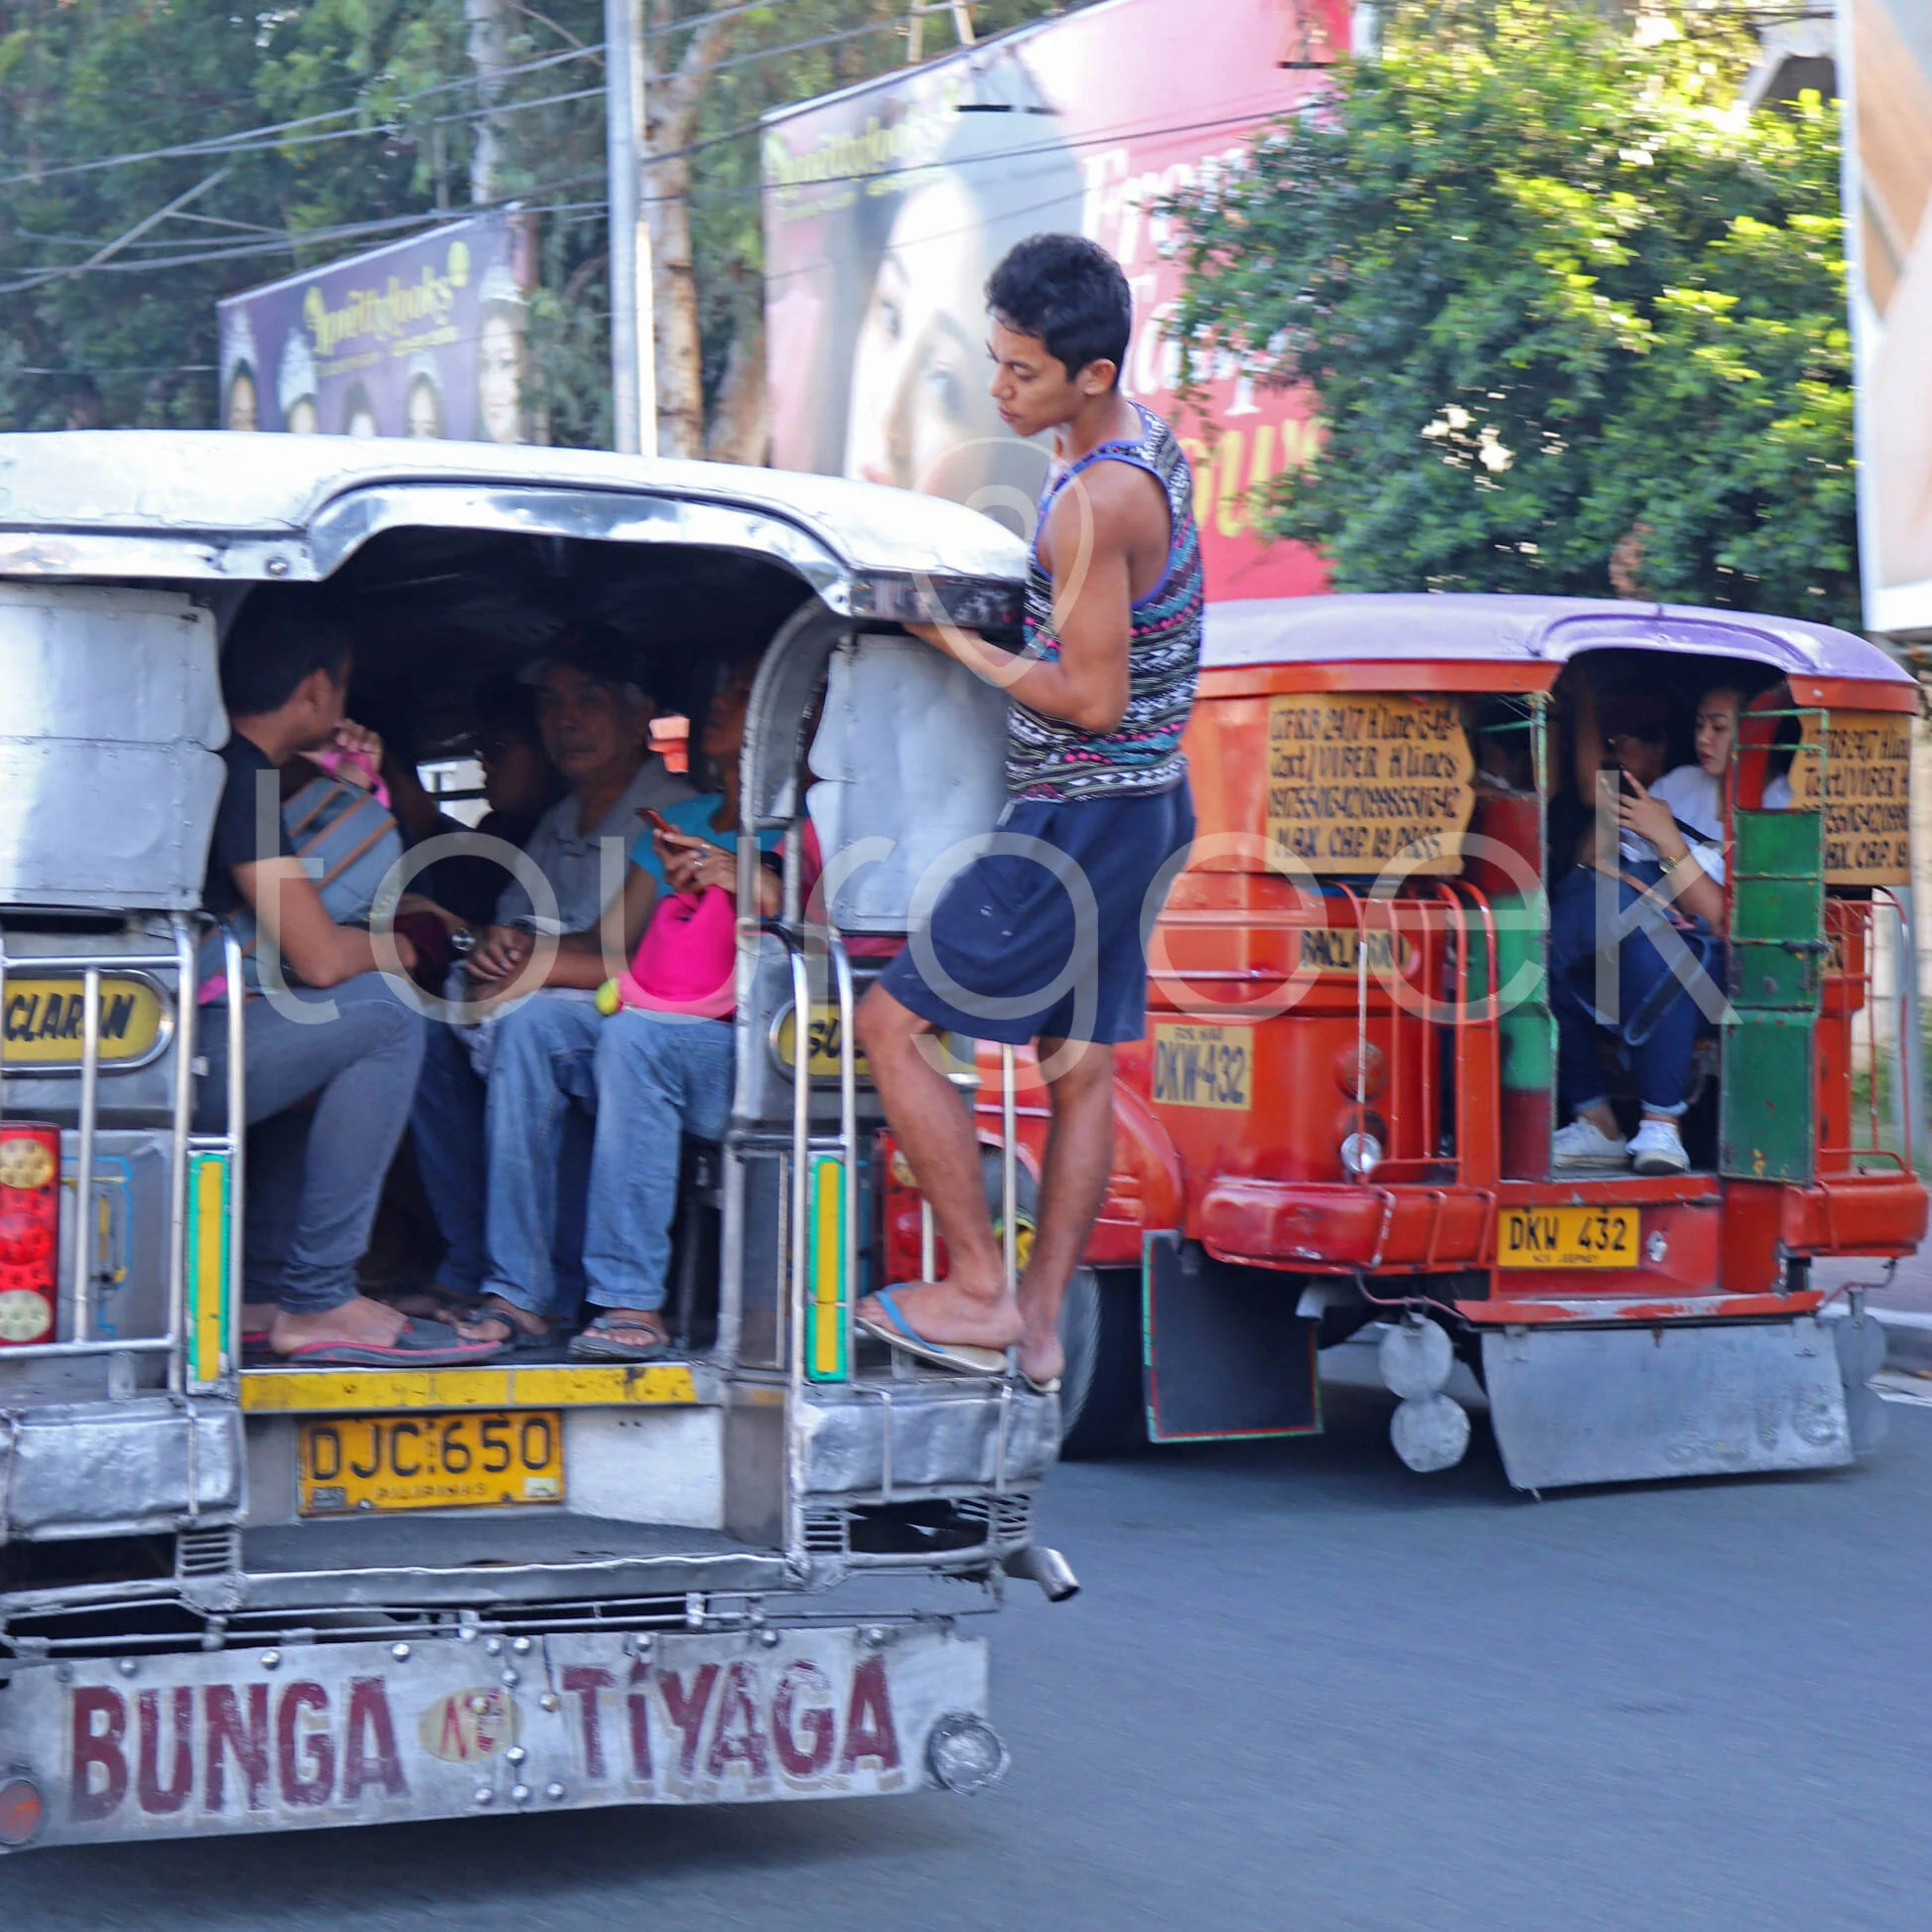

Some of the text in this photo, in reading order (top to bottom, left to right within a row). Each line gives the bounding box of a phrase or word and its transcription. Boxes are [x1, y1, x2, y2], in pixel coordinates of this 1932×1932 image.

[5, 995, 135, 1042] CLARN
[1509, 1216, 1626, 1252] DKW 432
[309, 1417, 552, 1481] DJC 650
[69, 1674, 409, 1822] BUNGA
